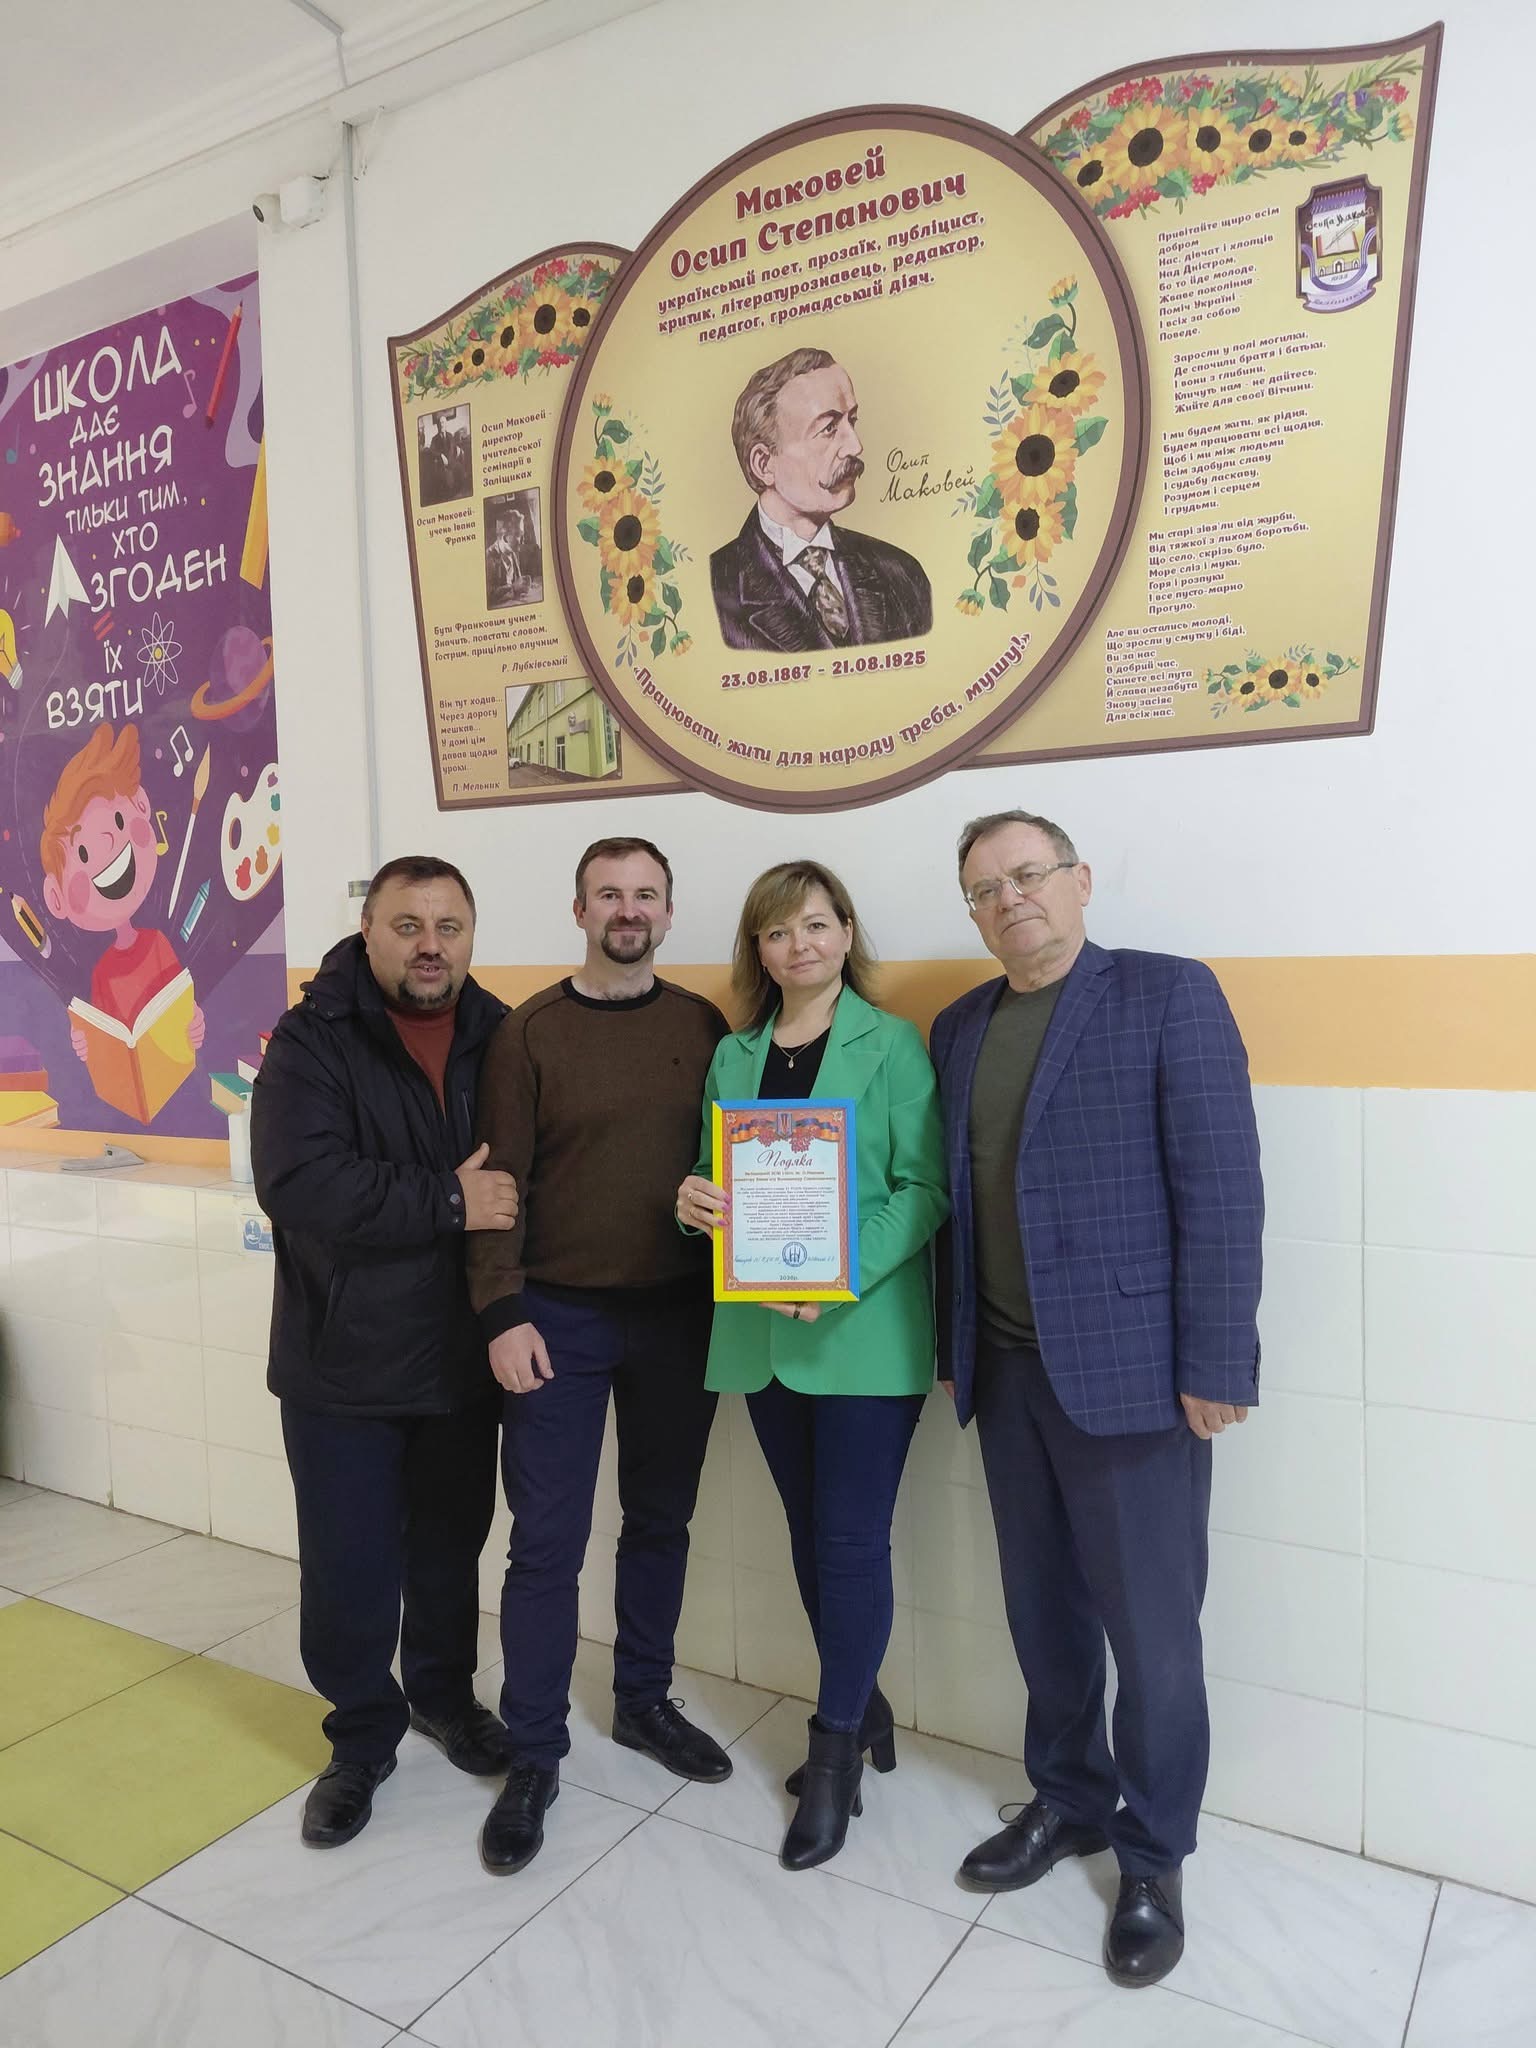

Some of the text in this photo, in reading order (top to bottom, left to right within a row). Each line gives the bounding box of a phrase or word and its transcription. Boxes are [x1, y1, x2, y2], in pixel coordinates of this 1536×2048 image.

[735, 145, 886, 220] Маковей
[670, 172, 967, 278] Осип Степанович
[1157, 207, 1279, 242] Привітайте щиро всім
[1157, 239, 1199, 255] добром
[1183, 247, 1220, 262] дівчат
[1229, 234, 1274, 250] хлопців
[657, 210, 985, 314] український поет, прозаїк, публіцист,
[658, 236, 985, 333] критик, літературознавець, редактор,
[1158, 269, 1180, 279] Над
[1158, 282, 1172, 291] Бо
[1189, 274, 1210, 284] йде
[699, 271, 935, 344] педагог, громадський діяч.
[1165, 316, 1188, 327] всіх
[1190, 314, 1203, 322] за
[1205, 306, 1241, 318] собою
[1173, 349, 1220, 363] Заросли
[1232, 339, 1256, 351] полі
[33, 325, 183, 423] ШКОЛА
[1173, 366, 1188, 377] Де
[1190, 358, 1236, 372] спочили
[1238, 350, 1275, 363] браття
[1174, 400, 1210, 413] Жийте
[1211, 397, 1233, 407] для
[1235, 389, 1265, 401] своєї
[69, 405, 120, 448] ДАЄ
[480, 422, 504, 433] Осип
[505, 409, 546, 426] Маковей
[481, 431, 523, 448] директор
[1162, 441, 1198, 453] Будем
[1200, 430, 1261, 447] працювати
[1263, 424, 1280, 434] всі
[481, 439, 541, 462] учительської
[38, 425, 173, 507] ЗНАННЯ
[481, 456, 524, 473] семінарії
[880, 447, 975, 503] Осип Маковей
[1163, 454, 1271, 477] Всім здобули славу
[482, 470, 532, 486] Заліщиках
[1170, 476, 1208, 490] судьбу
[1163, 489, 1210, 502] Розумом
[1219, 481, 1260, 493] серцем
[65, 480, 188, 535] ТІЛЬКИ ТИМ,
[416, 507, 475, 526] Осип Маковей-
[112, 521, 158, 559] ХТО
[428, 521, 476, 538] учень Івана
[444, 534, 476, 545] Франка
[1148, 544, 1166, 553] Від
[1168, 536, 1207, 549] тяжкої
[1217, 532, 1253, 542] лихом
[1148, 556, 1166, 565] Що
[1198, 546, 1233, 558] скрізь
[90, 543, 227, 613] ЗГОДЕН
[1104, 630, 1124, 638] Але
[1141, 623, 1188, 633] остались
[103, 639, 123, 674] ЇХ
[832, 650, 926, 677] 21.08.1925
[1106, 651, 1121, 662] Ви
[1136, 650, 1156, 658] нас
[1106, 671, 1192, 686] Скинете всі пута
[1117, 688, 1146, 696] слава
[1150, 682, 1197, 694] незабута
[46, 677, 144, 729] ВЗЯТИ
[632, 666, 722, 748] «Працювати,
[727, 739, 771, 763] жити
[776, 749, 813, 767] для
[819, 735, 895, 767] народу
[900, 699, 963, 744] треба,
[965, 632, 1032, 703] мушу!»
[1105, 694, 1175, 712] Знову засіяє
[1104, 710, 1128, 723] Для
[1128, 708, 1152, 718] всіх
[757, 1150, 813, 1168] Подяка
